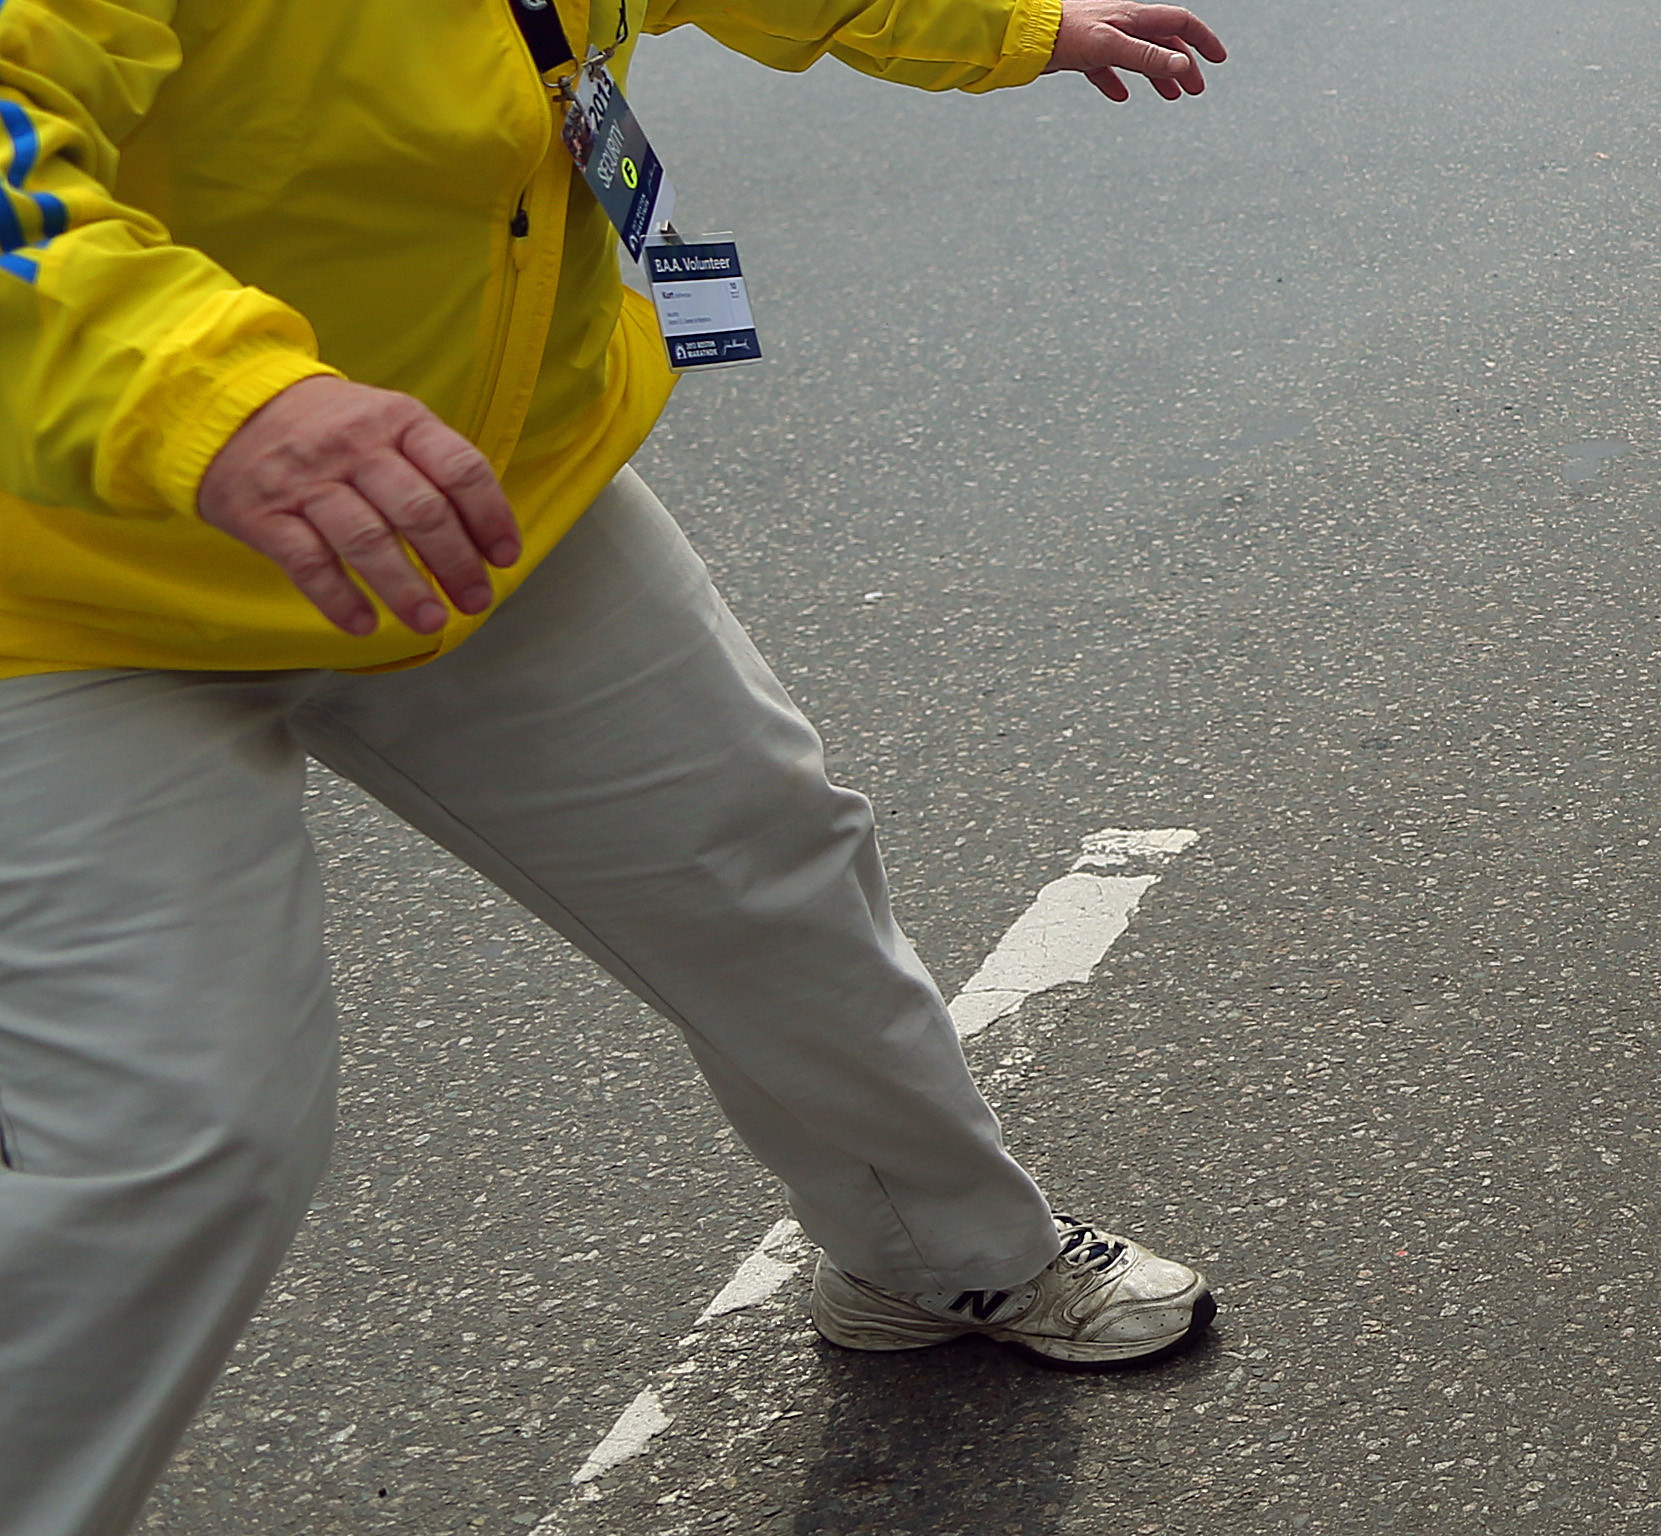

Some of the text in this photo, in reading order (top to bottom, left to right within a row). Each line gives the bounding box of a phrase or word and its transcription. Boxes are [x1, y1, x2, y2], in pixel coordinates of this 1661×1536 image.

[589, 68, 613, 131] 2013
[597, 119, 626, 189] SECURITY
[625, 161, 636, 185] F
[682, 255, 731, 272] Volunteer
